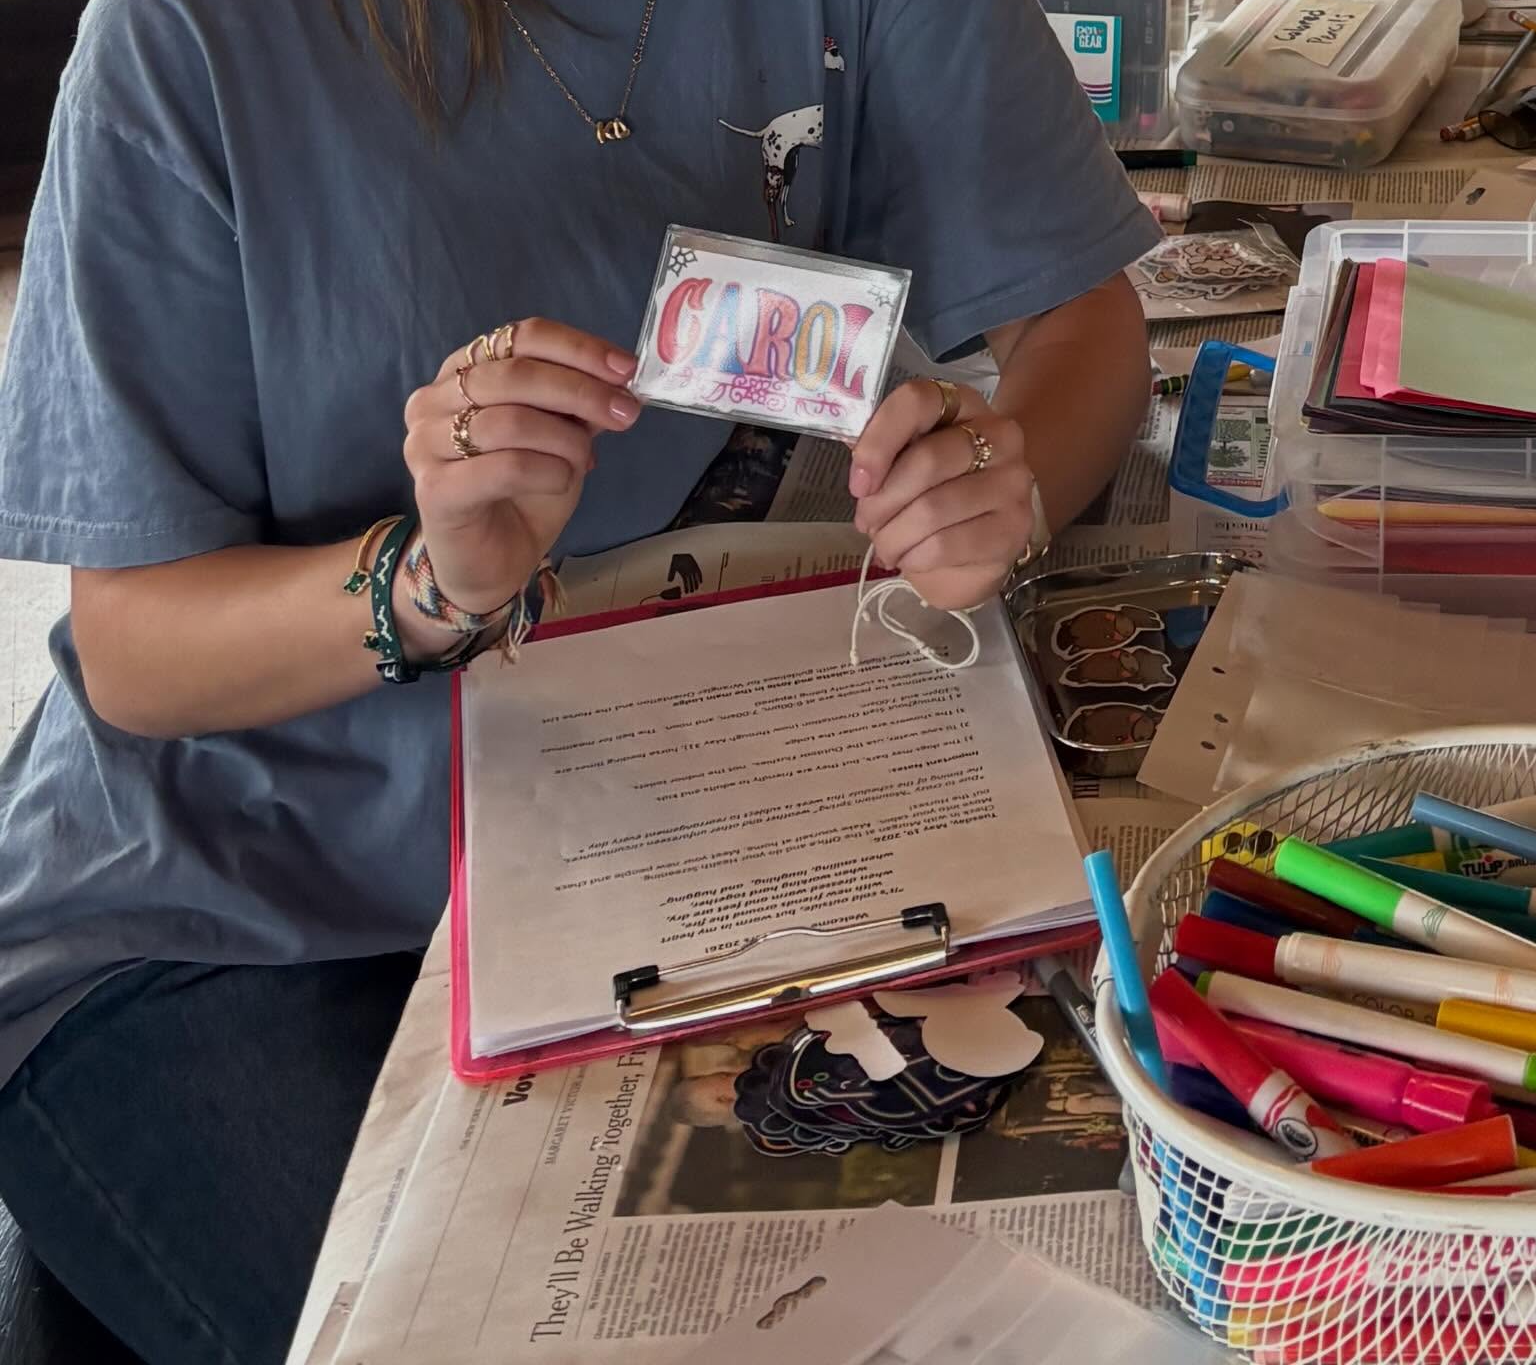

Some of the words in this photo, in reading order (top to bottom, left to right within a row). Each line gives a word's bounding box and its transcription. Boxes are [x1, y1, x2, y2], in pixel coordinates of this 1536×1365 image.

[1274, 10, 1326, 41] Colored
[1306, 14, 1355, 44] Pencils
[1079, 35, 1102, 48] GEAR
[657, 277, 875, 402] CAROL
[925, 750, 978, 766] Important
[949, 812, 997, 824] Tuesday,
[923, 822, 947, 831] May
[860, 852, 893, 862] when
[834, 865, 867, 876] when
[859, 869, 893, 880] when
[751, 869, 807, 885] laughing,
[781, 873, 831, 889] working
[720, 883, 743, 893] and
[749, 885, 778, 896] hard
[809, 876, 856, 893] dressed
[854, 881, 882, 891] with
[771, 888, 806, 900] warm
[825, 887, 852, 897] new
[851, 891, 877, 901] cold
[690, 891, 746, 907] together,
[744, 896, 768, 907] and
[780, 892, 823, 907] friends
[799, 897, 848, 911] outside,
[693, 907, 713, 917] are
[717, 900, 741, 912] feet
[732, 903, 777, 919] around
[666, 913, 690, 922] dry,
[709, 914, 729, 923] the
[775, 908, 795, 918] but
[681, 917, 706, 928] fire,
[735, 914, 772, 926] warm
[811, 912, 869, 929] Welcome
[660, 930, 695, 943] heart
[697, 926, 717, 935] my
[590, 1072, 645, 1152] Together,
[563, 1154, 620, 1235] Walking
[554, 1236, 589, 1265] Be
[529, 1270, 580, 1343] They'll
